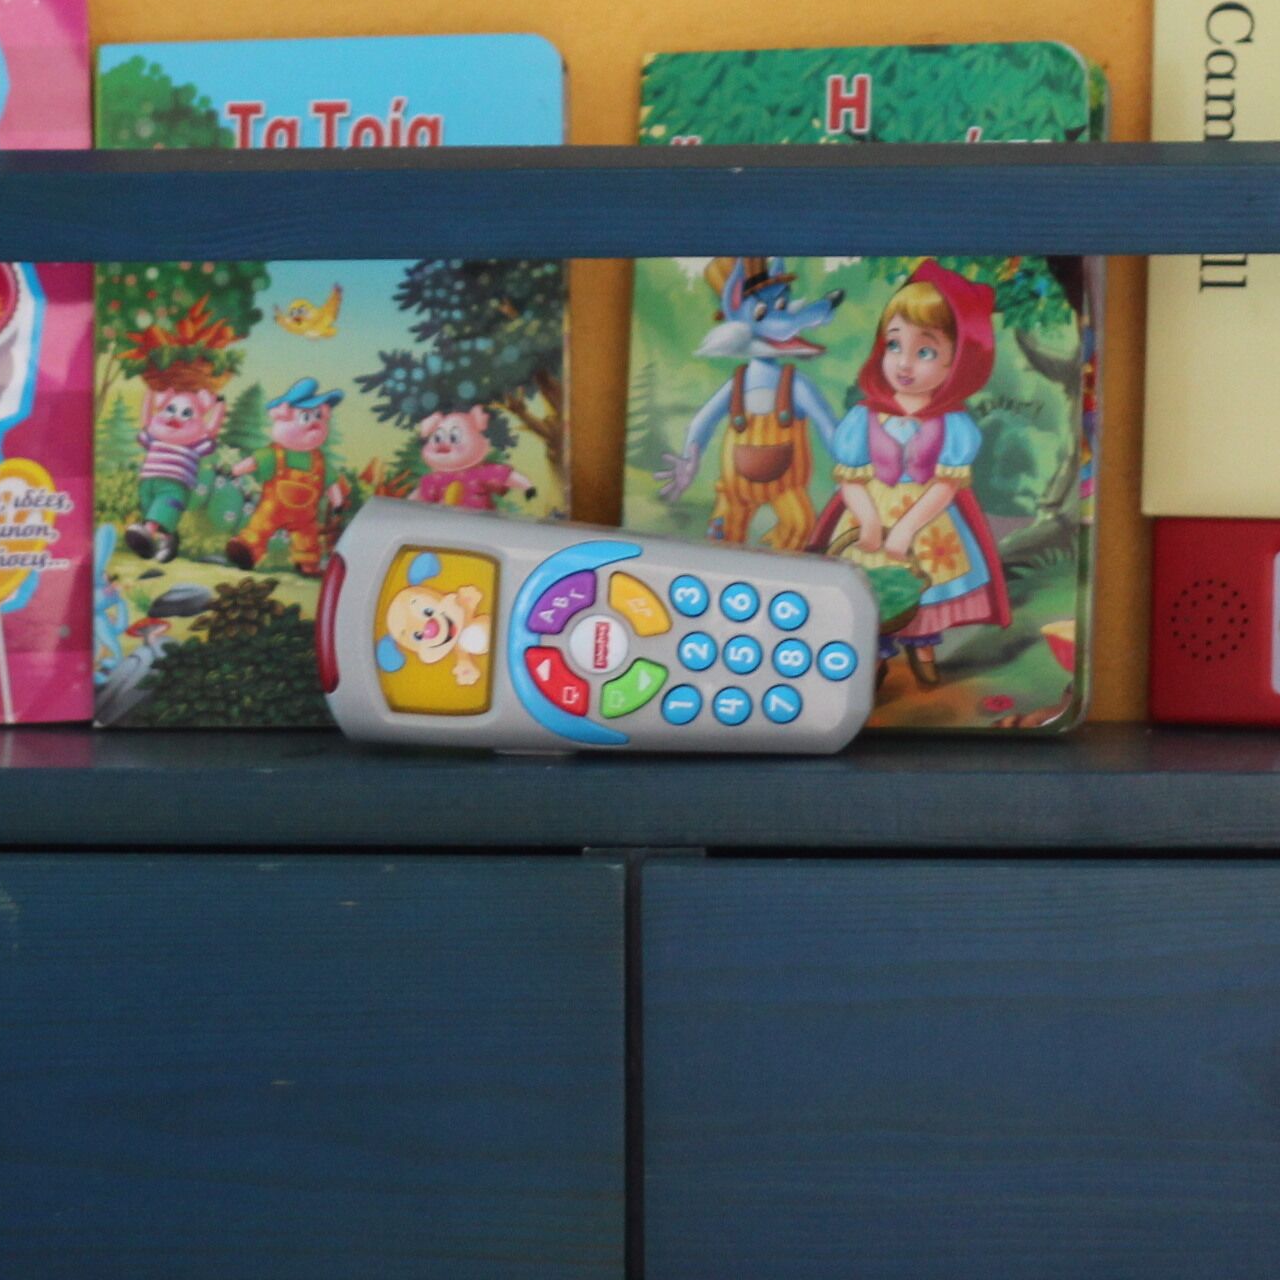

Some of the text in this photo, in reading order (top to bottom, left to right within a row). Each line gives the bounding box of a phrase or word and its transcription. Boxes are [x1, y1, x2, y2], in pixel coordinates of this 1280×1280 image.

[674, 587, 703, 605] 3
[727, 593, 752, 611] 6
[775, 601, 801, 619] 9
[683, 642, 709, 660] 2
[730, 646, 755, 664] 5
[780, 649, 805, 667] 8
[824, 652, 850, 671] 0
[718, 699, 744, 715] 4
[769, 696, 795, 713] 7
